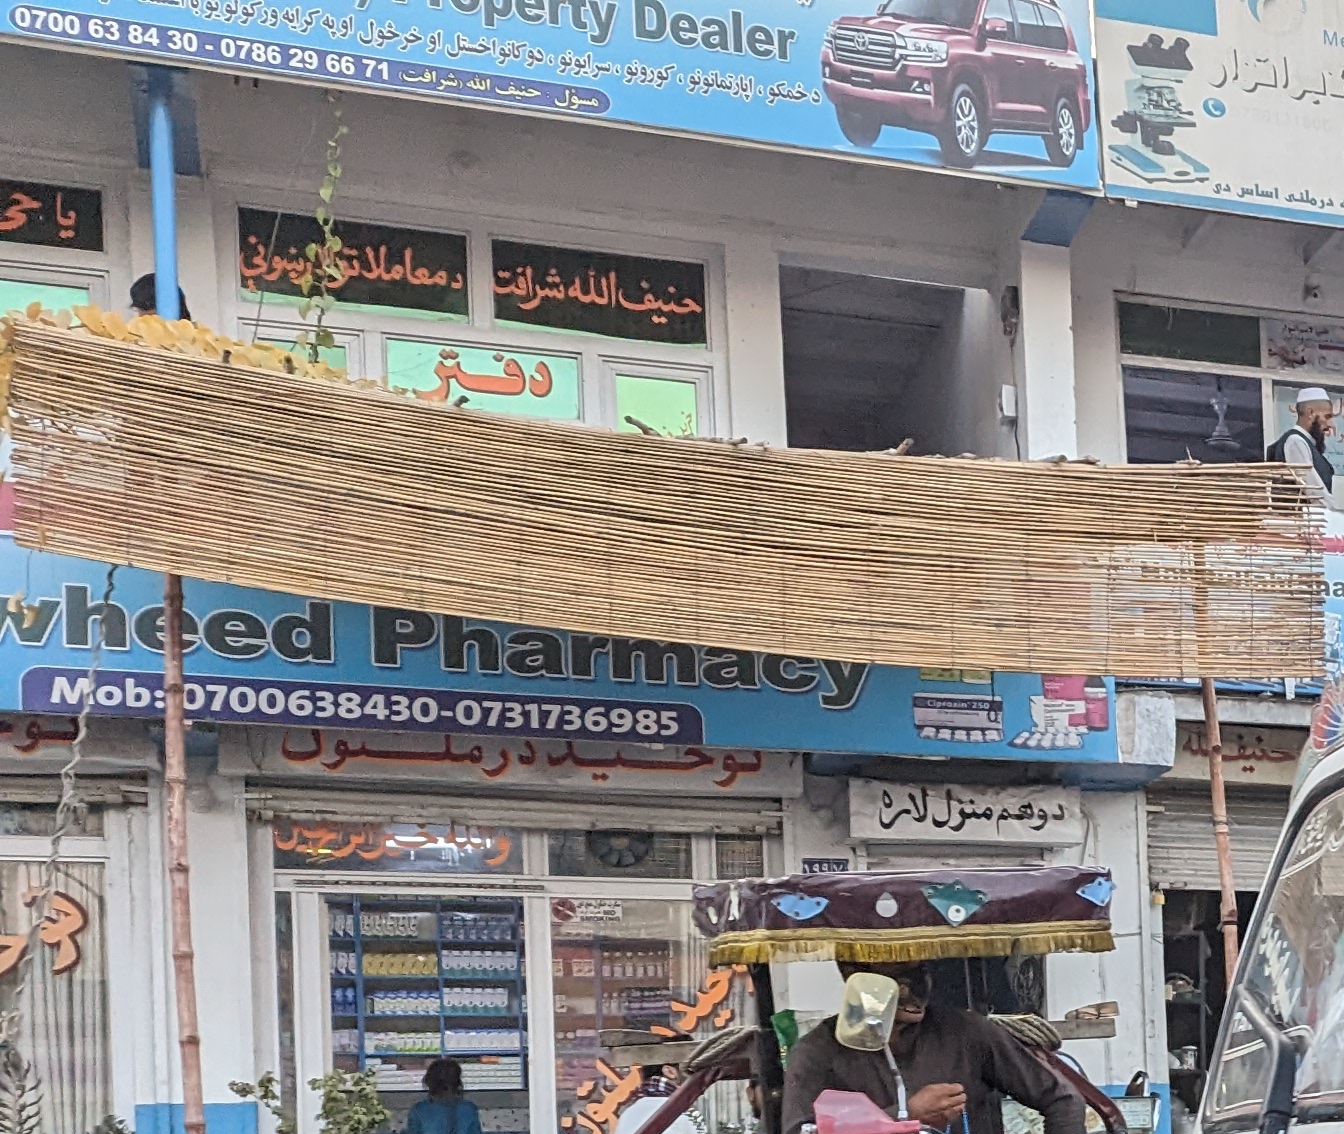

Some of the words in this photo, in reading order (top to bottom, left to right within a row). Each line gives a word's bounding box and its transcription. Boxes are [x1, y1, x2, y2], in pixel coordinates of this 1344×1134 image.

[14, 7, 81, 36] 0700
[88, 18, 121, 41] 63
[127, 24, 160, 47] 84
[166, 30, 199, 53] 30
[219, 37, 282, 66] 0786
[287, 47, 319, 71] 29
[325, 53, 356, 76] 66
[361, 58, 390, 81] 71
[426, 31, 442, 54] او
[635, 0, 798, 62] Dealer
[466, 76, 492, 93] الله
[492, 265, 566, 311] شرافت
[568, 266, 617, 309] الله
[618, 278, 703, 325] حنیف
[411, 346, 554, 401] دفتر
[370, 604, 872, 710] Pharmacy
[181, 680, 679, 738] 0700638430-0731736985
[931, 787, 995, 832] منزل
